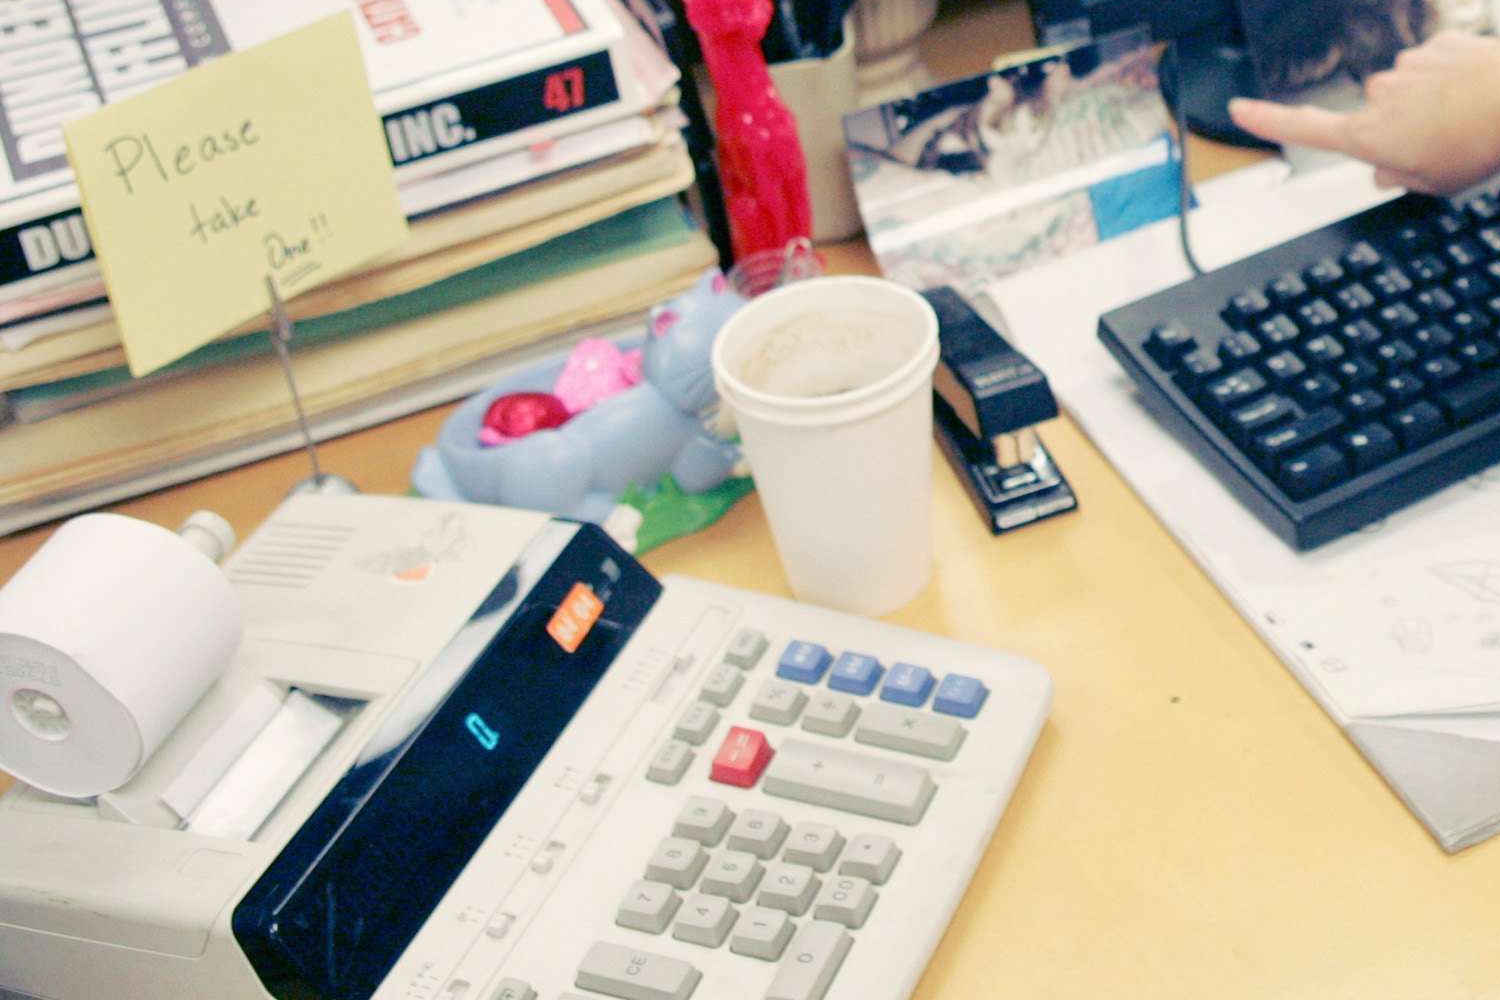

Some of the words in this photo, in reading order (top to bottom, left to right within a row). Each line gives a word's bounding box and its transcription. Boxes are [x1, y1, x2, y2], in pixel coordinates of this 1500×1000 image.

[385, 102, 478, 164] INC.
[543, 66, 586, 112] 47
[104, 119, 261, 195] Please
[190, 196, 262, 244] take
[626, 956, 648, 976] CE
